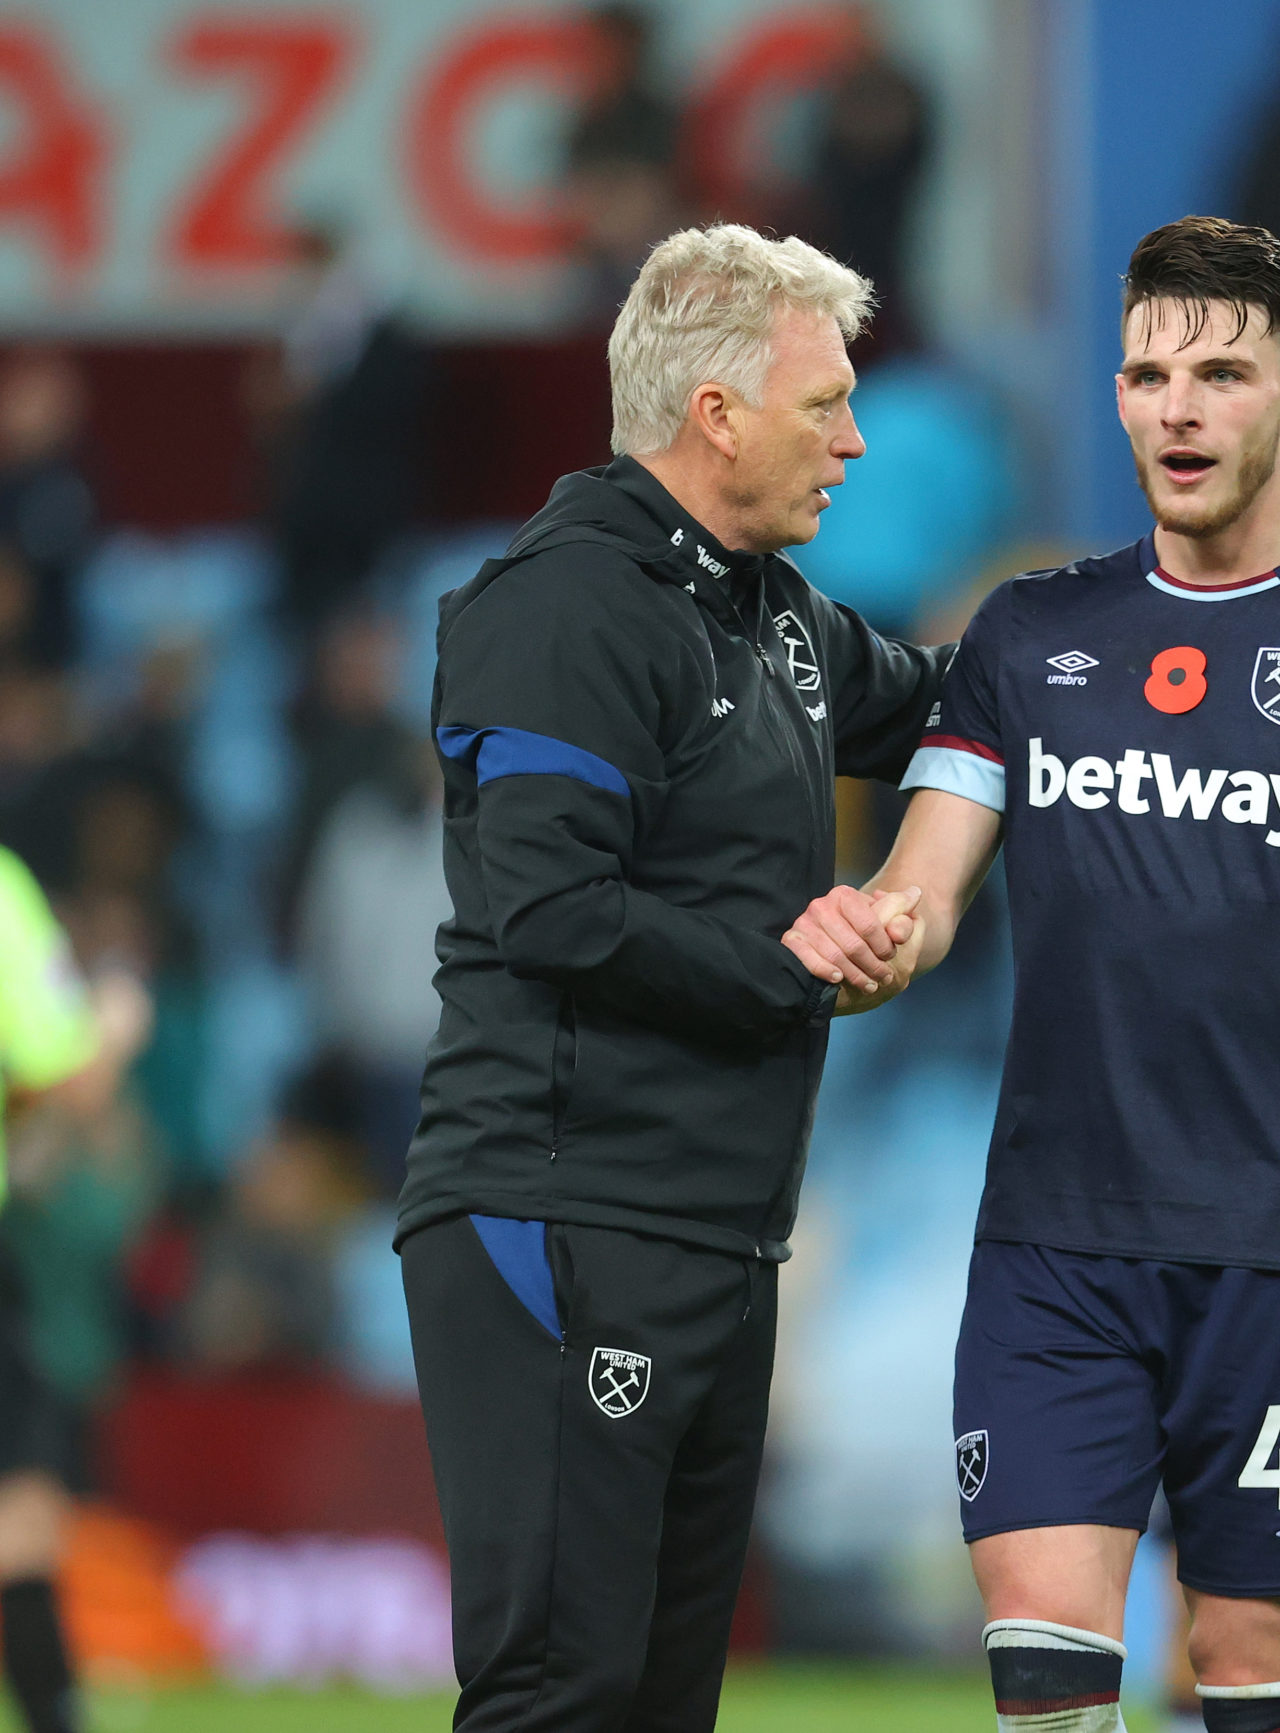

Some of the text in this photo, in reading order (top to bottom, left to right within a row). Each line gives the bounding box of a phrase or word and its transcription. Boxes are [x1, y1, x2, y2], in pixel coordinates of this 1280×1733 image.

[1046, 673, 1088, 686] umbro
[600, 1352, 646, 1369] WEST HAM
